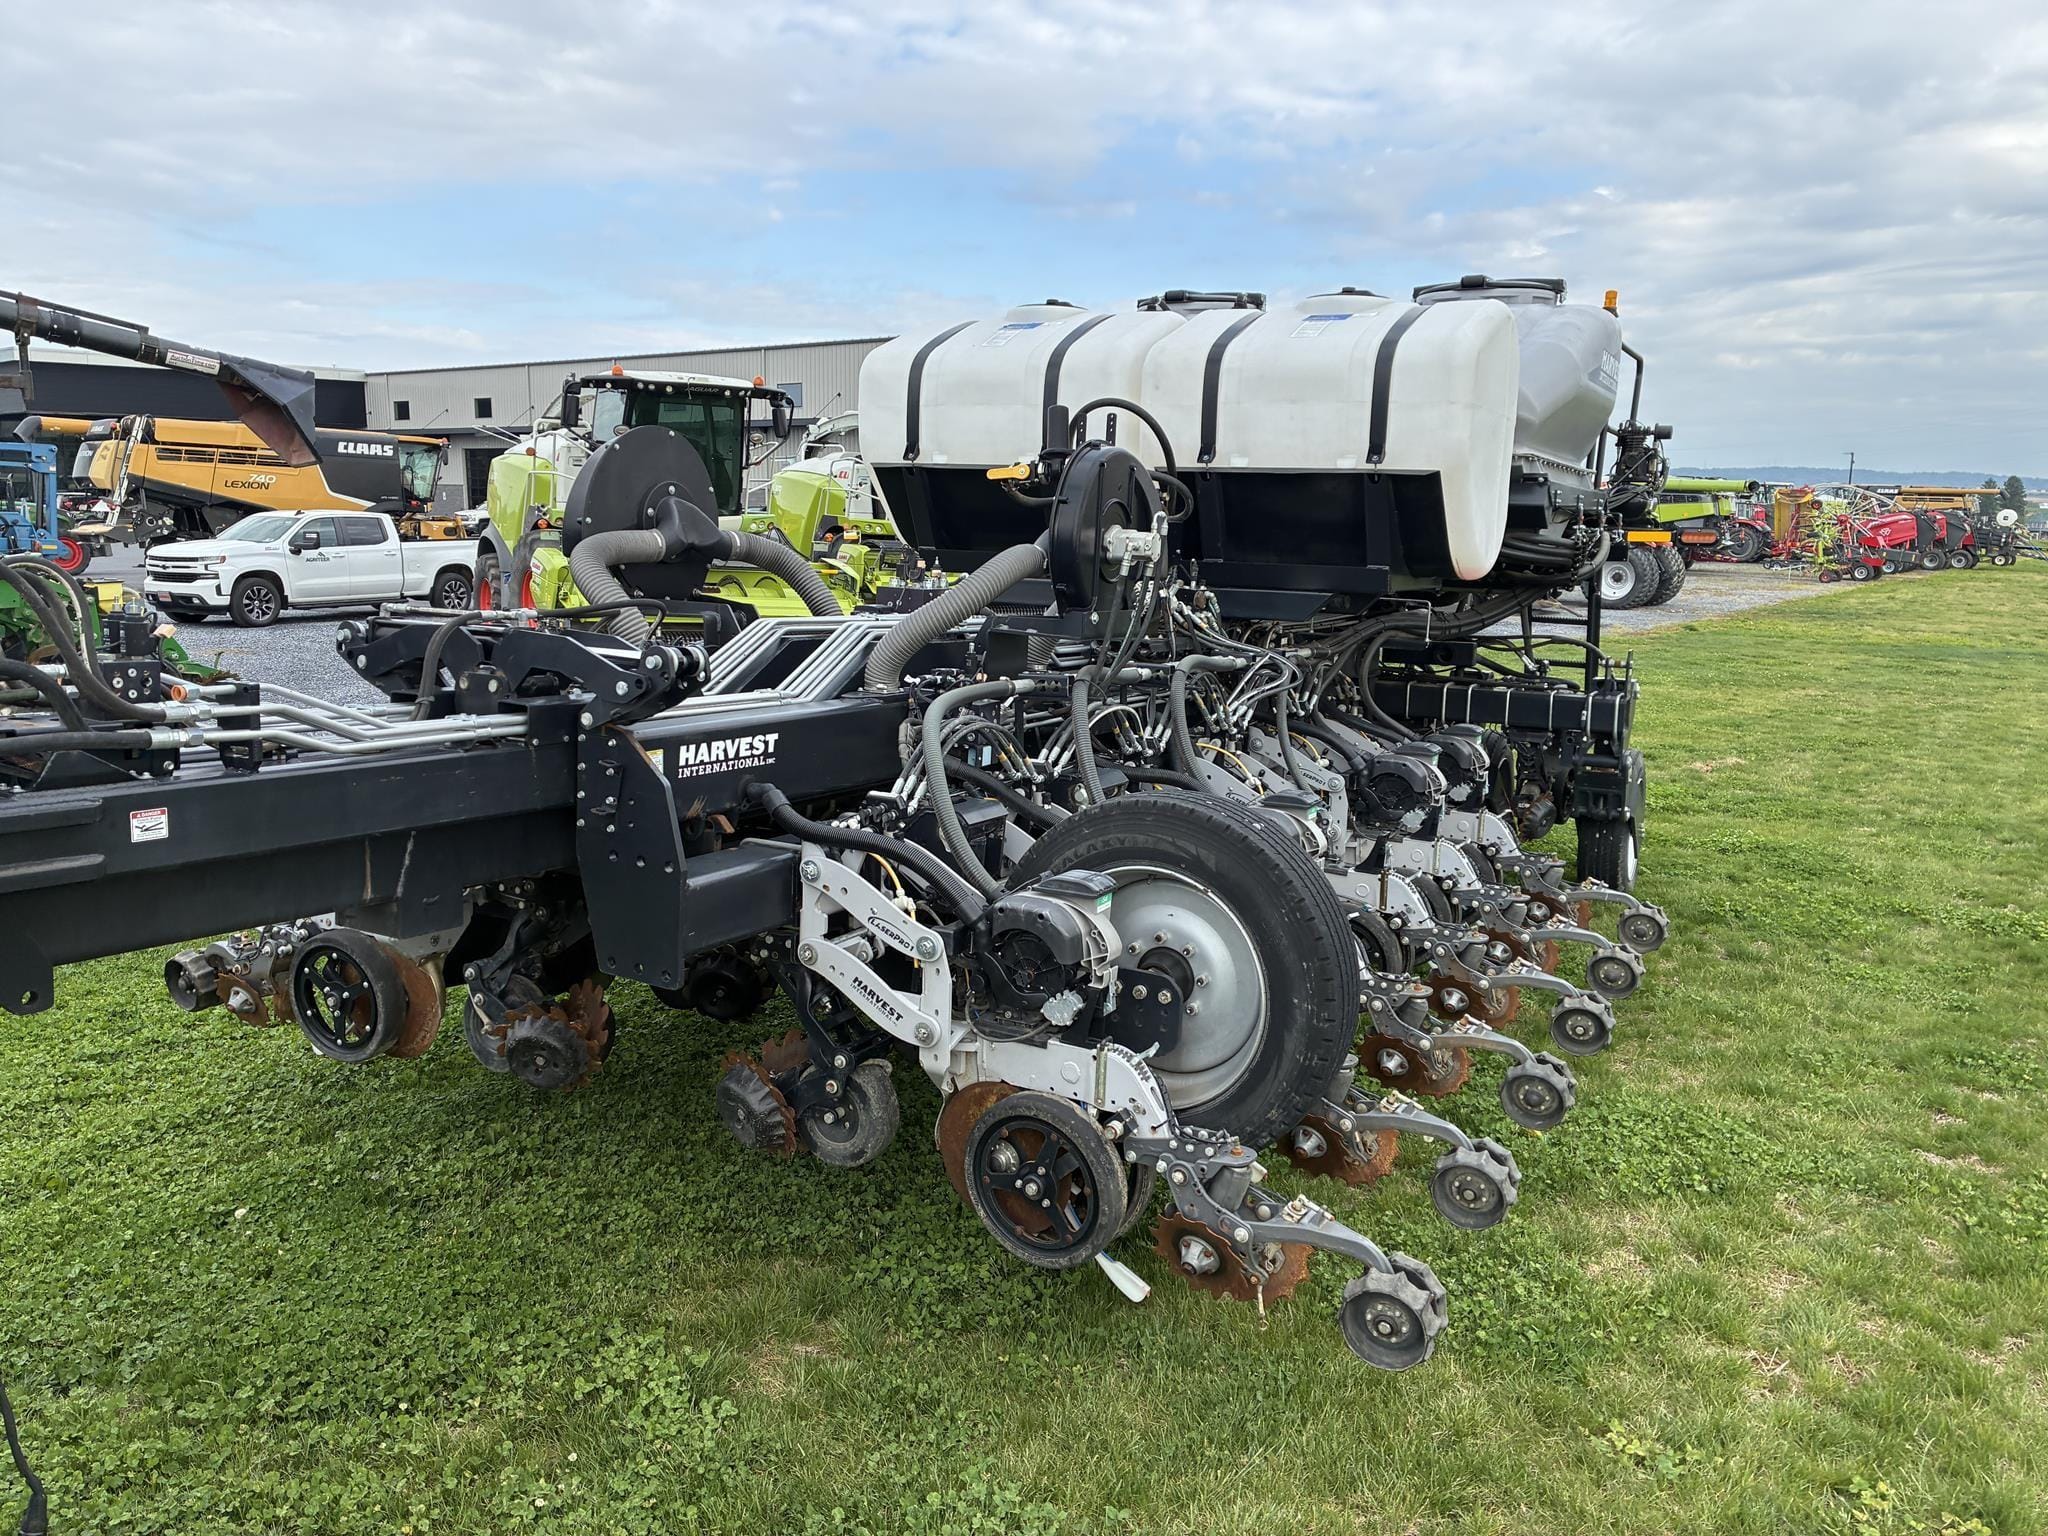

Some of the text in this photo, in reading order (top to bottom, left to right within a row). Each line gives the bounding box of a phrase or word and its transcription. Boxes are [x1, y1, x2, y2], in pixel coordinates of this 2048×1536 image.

[337, 442, 394, 457] CLAAS
[224, 479, 270, 490] LEXION
[249, 474, 276, 483] 740
[679, 733, 779, 767] HARVEST
[678, 756, 765, 779] INTERNATIONAL
[850, 983, 892, 1022] INTERNATIONAL
[852, 976, 903, 1021] HARVEST
